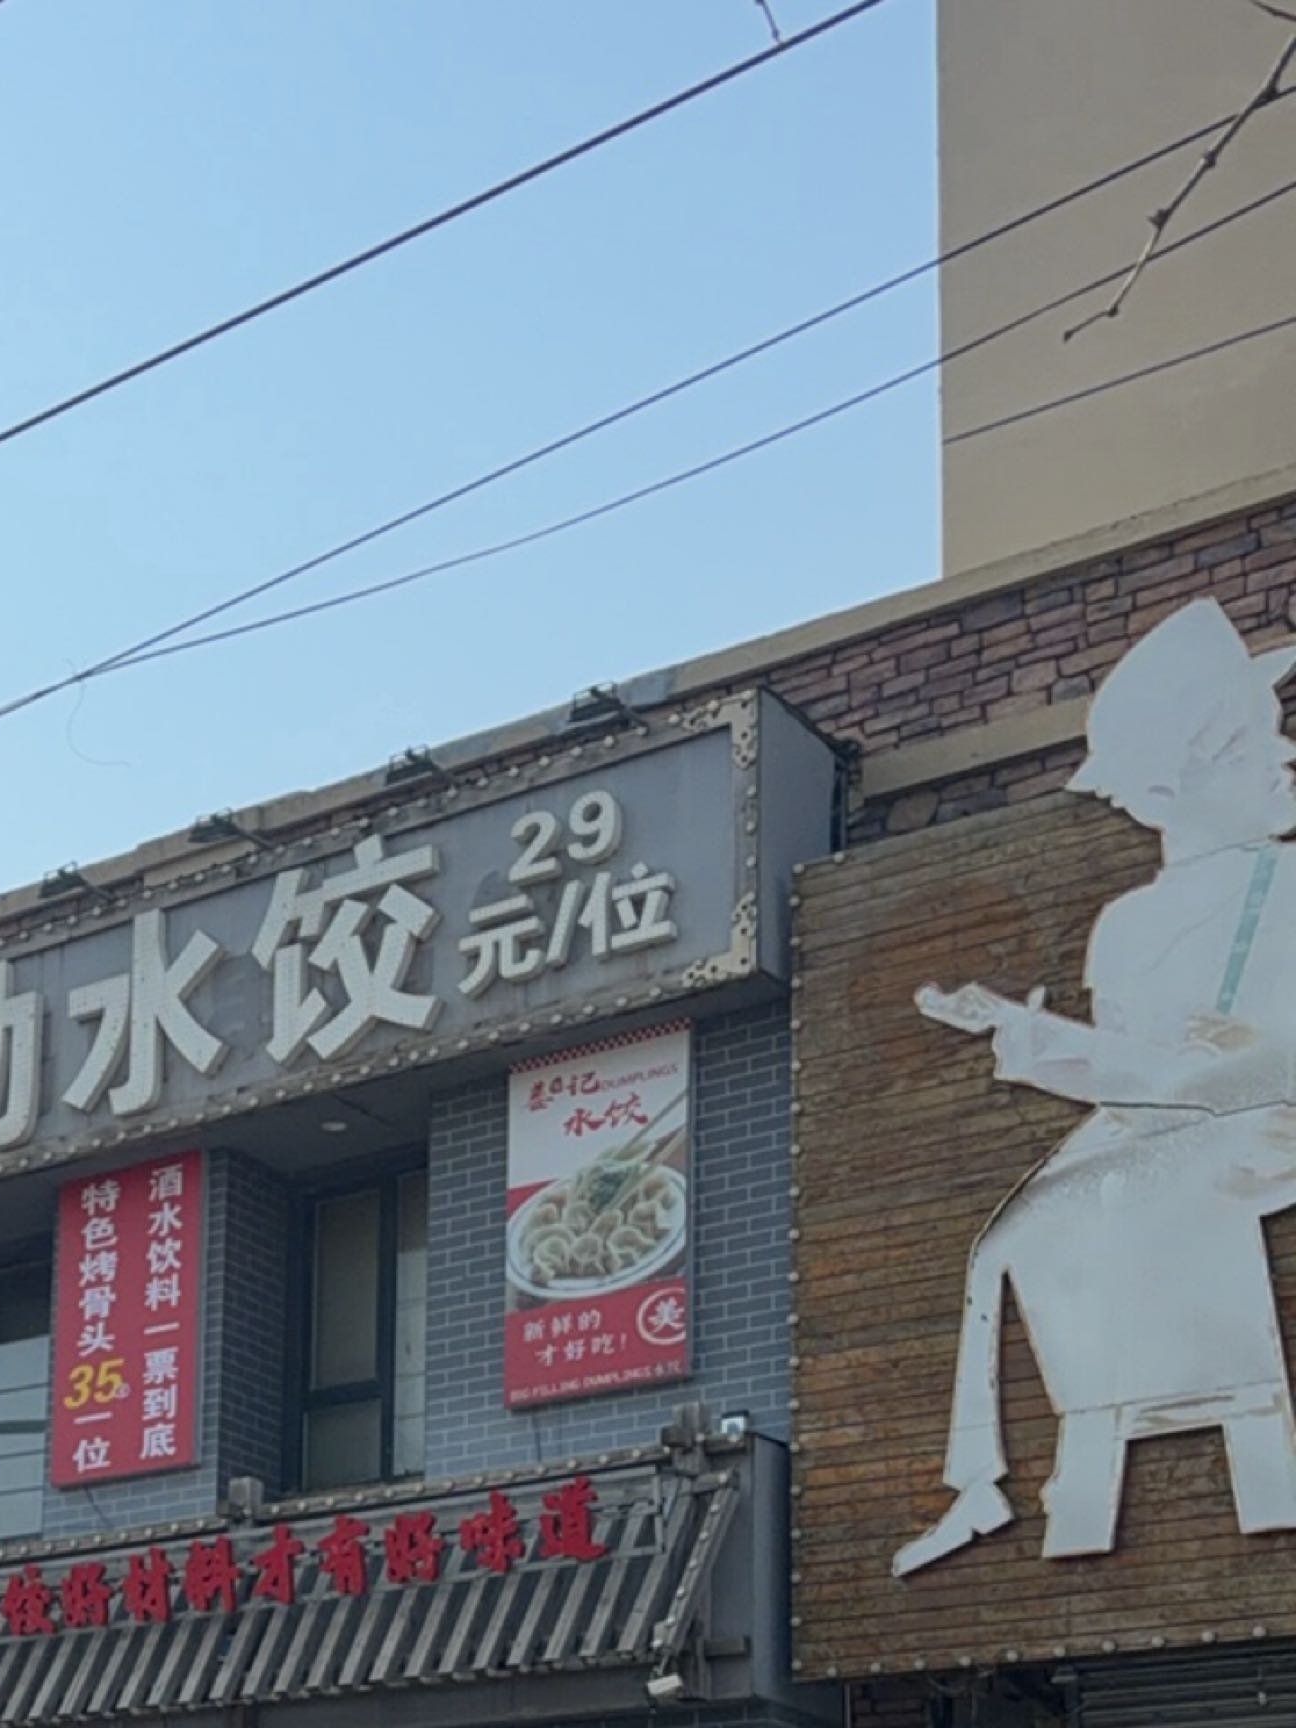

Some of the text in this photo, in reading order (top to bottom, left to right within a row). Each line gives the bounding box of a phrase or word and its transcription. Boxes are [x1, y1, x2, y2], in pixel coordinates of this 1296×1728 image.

[510, 791, 624, 889] 29
[458, 862, 679, 1000] 元/位
[564, 1092, 648, 1136] 水饺
[140, 1163, 184, 1460] 酒水饮料一票到底
